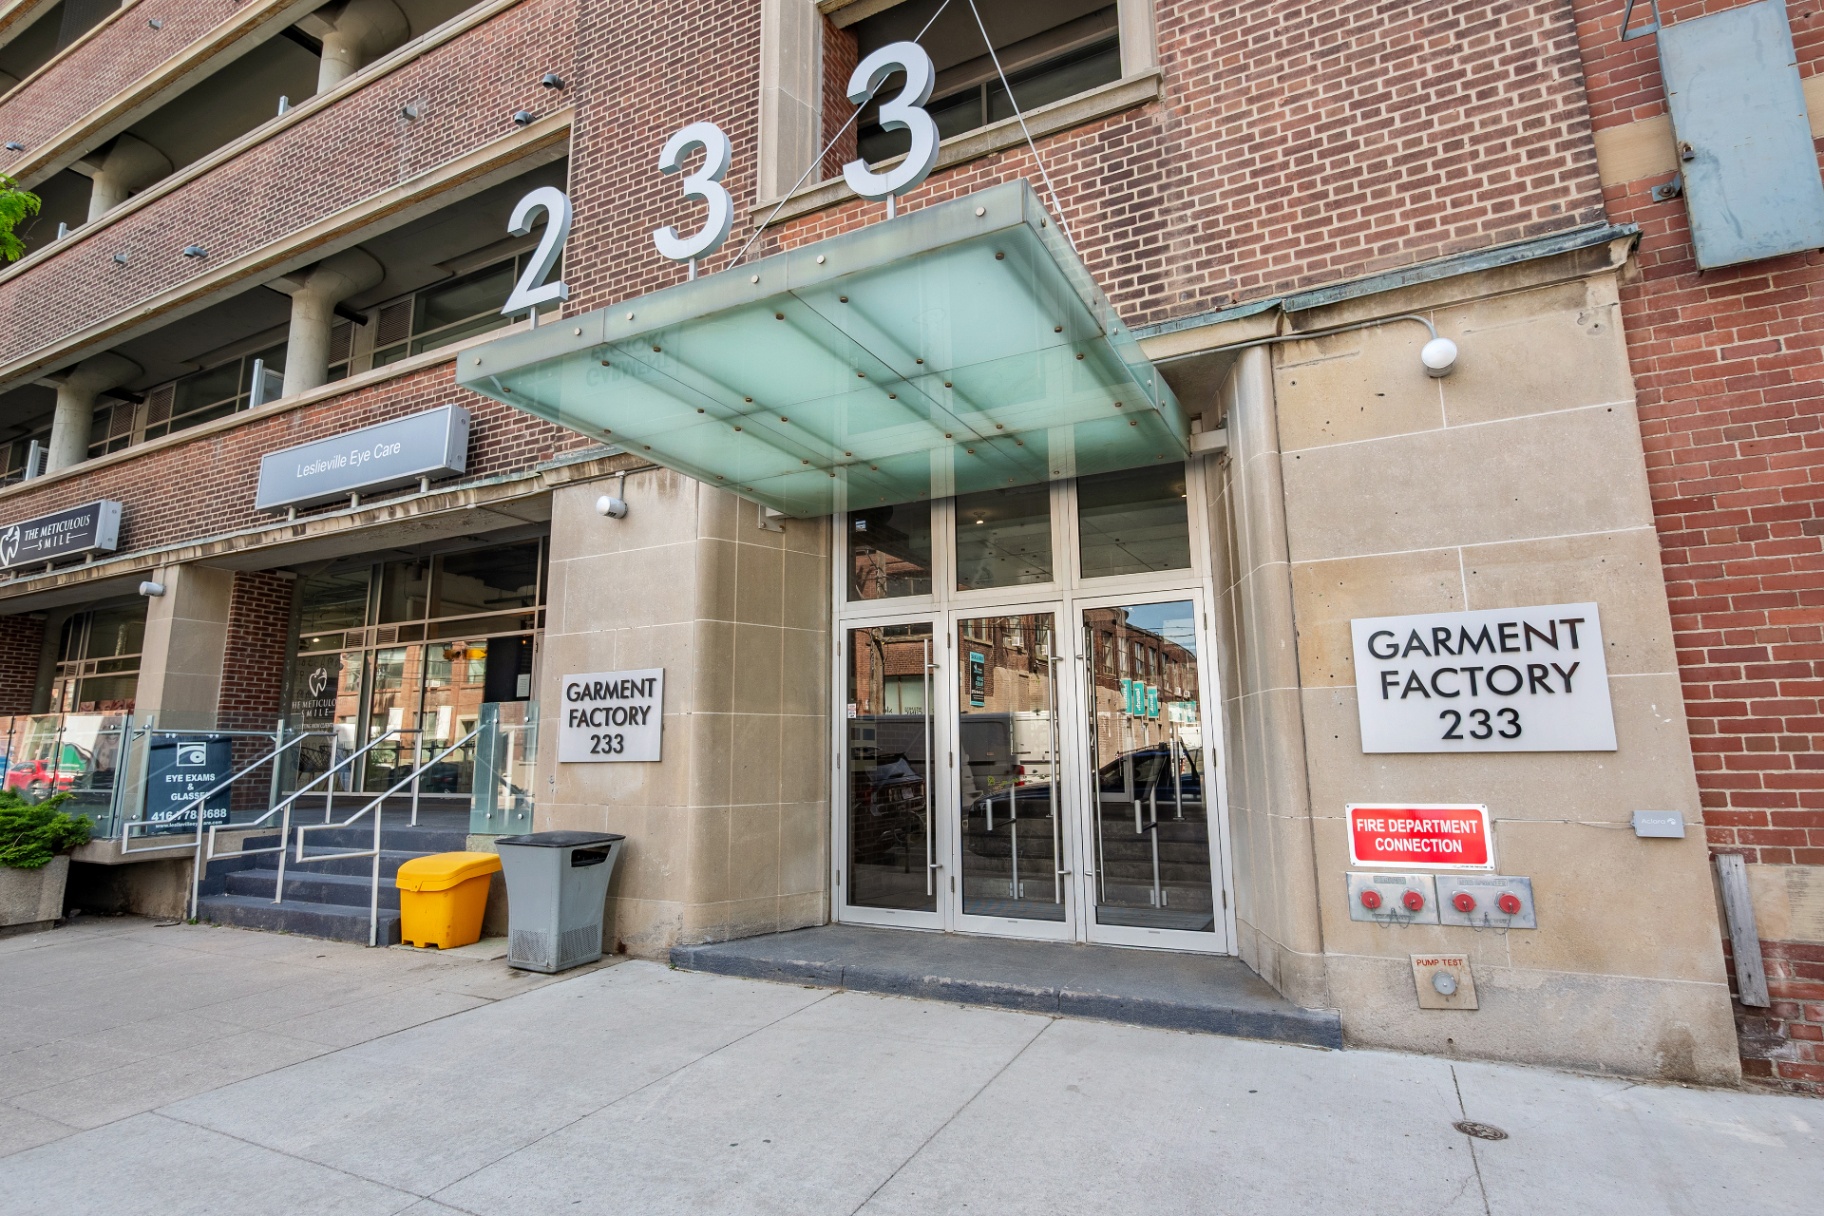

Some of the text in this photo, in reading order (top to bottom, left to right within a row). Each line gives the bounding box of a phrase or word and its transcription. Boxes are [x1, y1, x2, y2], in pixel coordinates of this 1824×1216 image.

[296, 442, 401, 478] Leslieville Eye Care
[25, 515, 91, 541] THE METICULOUS
[38, 532, 71, 551] SMILE
[1367, 617, 1585, 660] GARMENT
[566, 678, 657, 702] GARMENT
[1380, 661, 1581, 700] FACTORY
[291, 698, 346, 709] HE METICULO
[301, 708, 329, 718] SMILE
[569, 705, 651, 728] FACTORY
[1439, 707, 1523, 740] 233
[590, 733, 624, 754] 233
[185, 773, 216, 782] EXAMS
[187, 783, 194, 791] &
[1356, 818, 1478, 834] FIRE DEPARTMENT
[1375, 837, 1463, 853] CONNECTION
